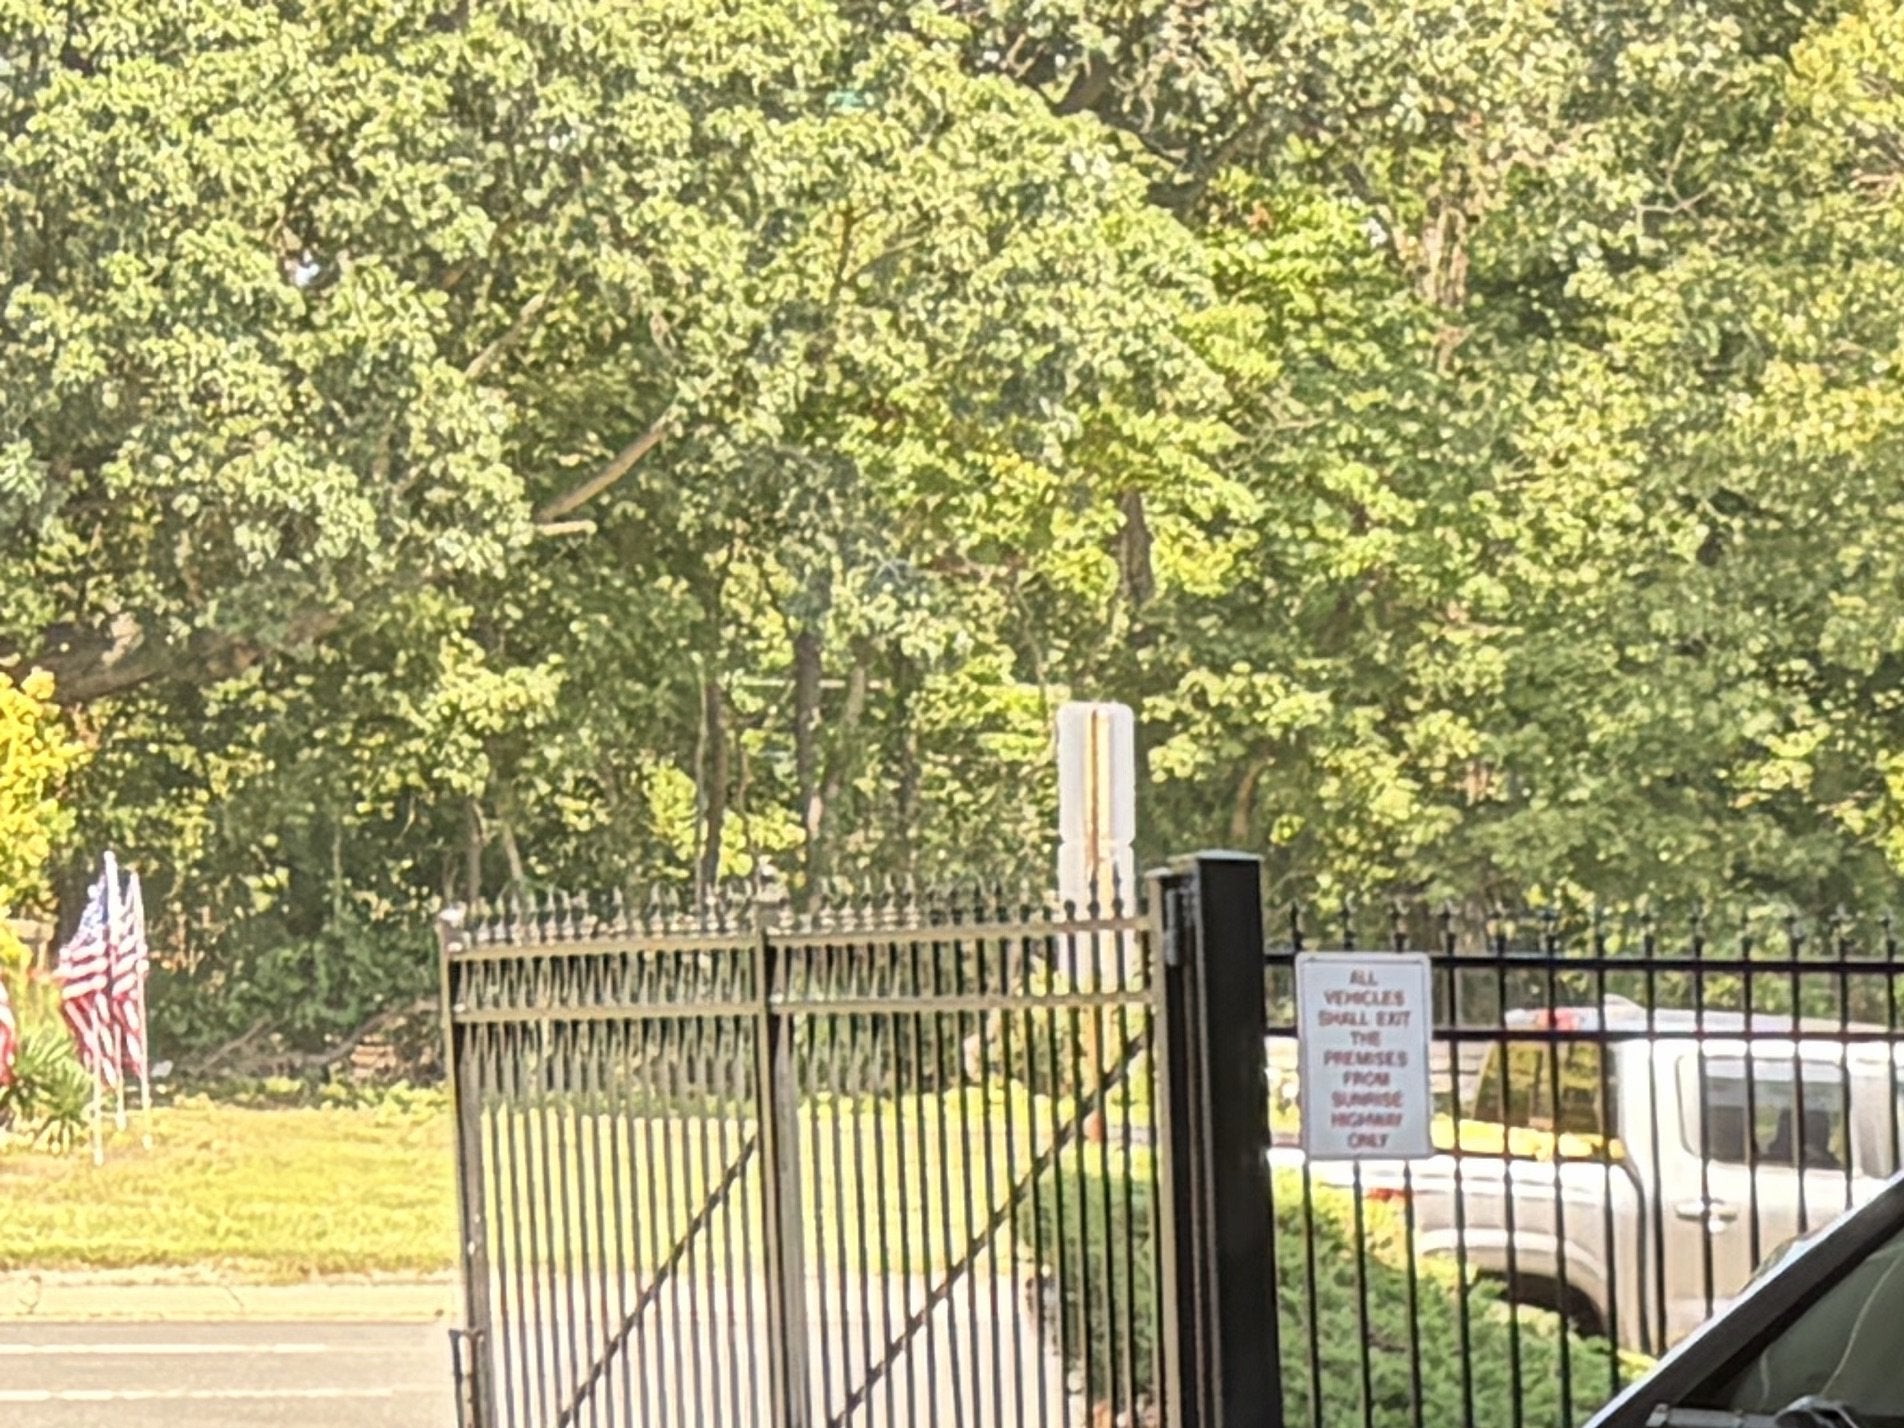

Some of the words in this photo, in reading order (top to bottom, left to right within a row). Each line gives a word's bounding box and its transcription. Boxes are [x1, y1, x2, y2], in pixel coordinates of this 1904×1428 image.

[1350, 970, 1378, 985] ALL
[1324, 991, 1404, 1006] VEHICLES
[1318, 1010, 1368, 1026] SHALL
[1376, 1011, 1410, 1026] EXIT
[1350, 1031, 1380, 1046] THE
[1324, 1051, 1408, 1067] PREMISES
[1343, 1072, 1390, 1087] FROM
[1347, 1134, 1389, 1149] ONLY
